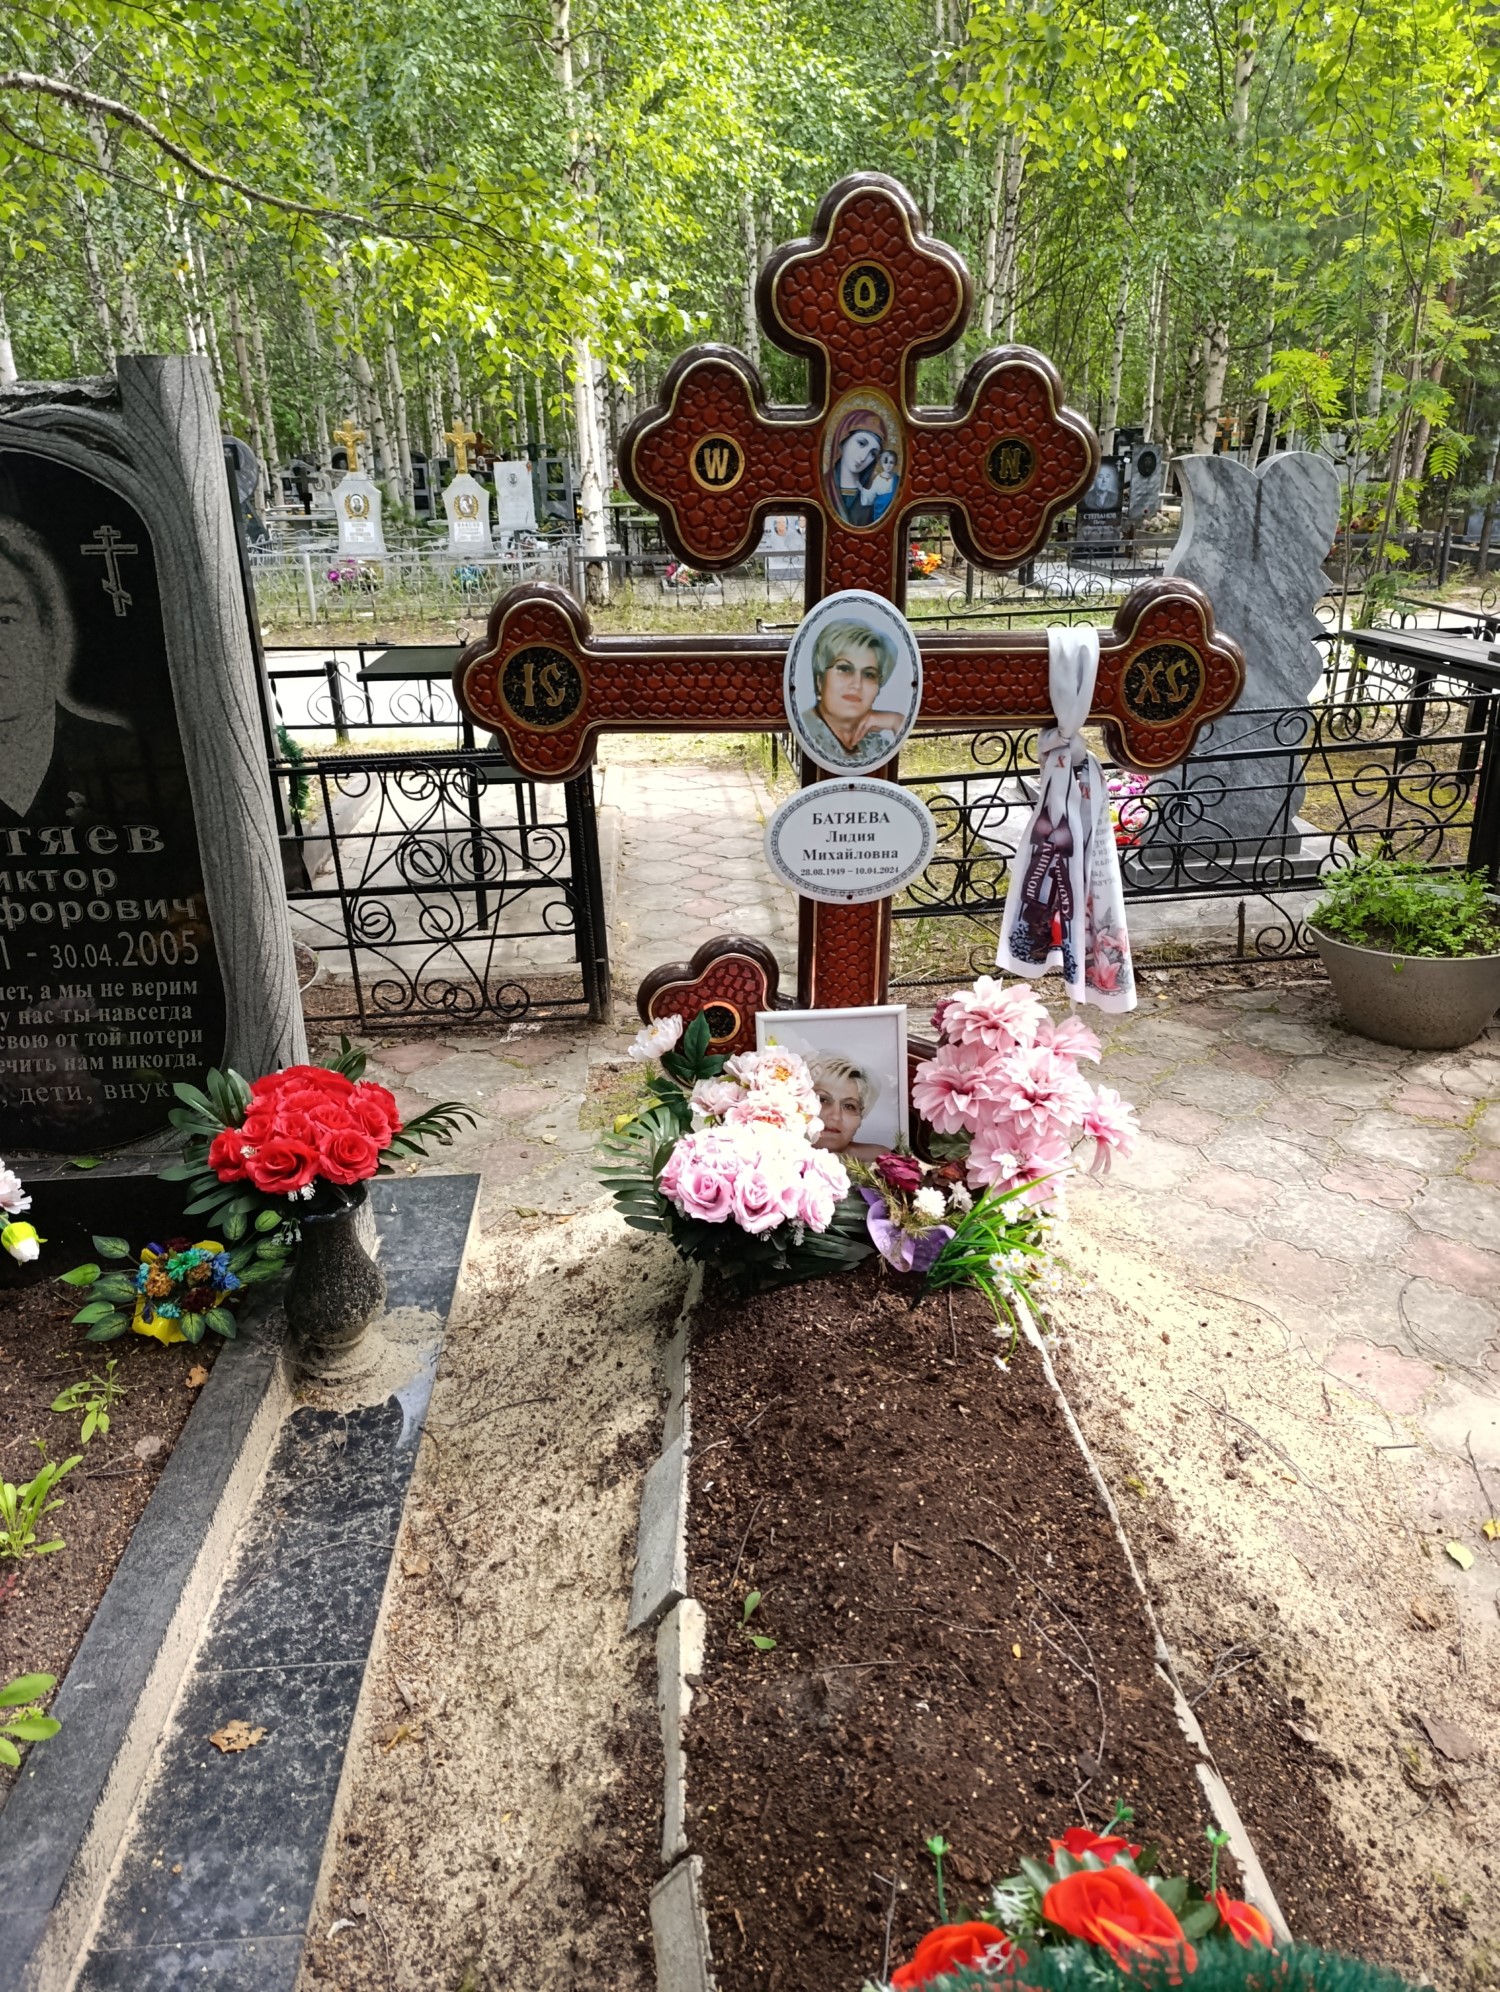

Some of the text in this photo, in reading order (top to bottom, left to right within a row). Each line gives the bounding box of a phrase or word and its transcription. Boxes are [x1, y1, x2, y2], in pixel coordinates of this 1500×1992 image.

[1083, 512, 1117, 520] СТЕПАНОВ
[812, 811, 891, 825] БАТЯЕВА
[825, 830, 876, 843] Лидия
[802, 848, 899, 861] Михайловна
[800, 867, 846, 876] 28.08.1949
[855, 866, 900, 875] 10.04.2024
[1026, 842, 1053, 898] ПОМНИМ
[0, 896, 197, 931] форович
[50, 930, 199, 969] 30.04.2005
[40, 985, 51, 999] а
[59, 983, 92, 998] мы
[100, 982, 125, 997] не
[131, 980, 198, 1001] верим
[18, 1008, 54, 1024] нас
[60, 1008, 91, 1023] ты
[98, 1005, 193, 1023] навсегда
[55, 1033, 79, 1048] от
[84, 1027, 122, 1047] той
[129, 1029, 203, 1049] потери
[64, 1056, 105, 1071] нам
[111, 1052, 203, 1070] никогда.
[19, 1085, 93, 1106] дети,
[103, 1082, 177, 1104] внук
